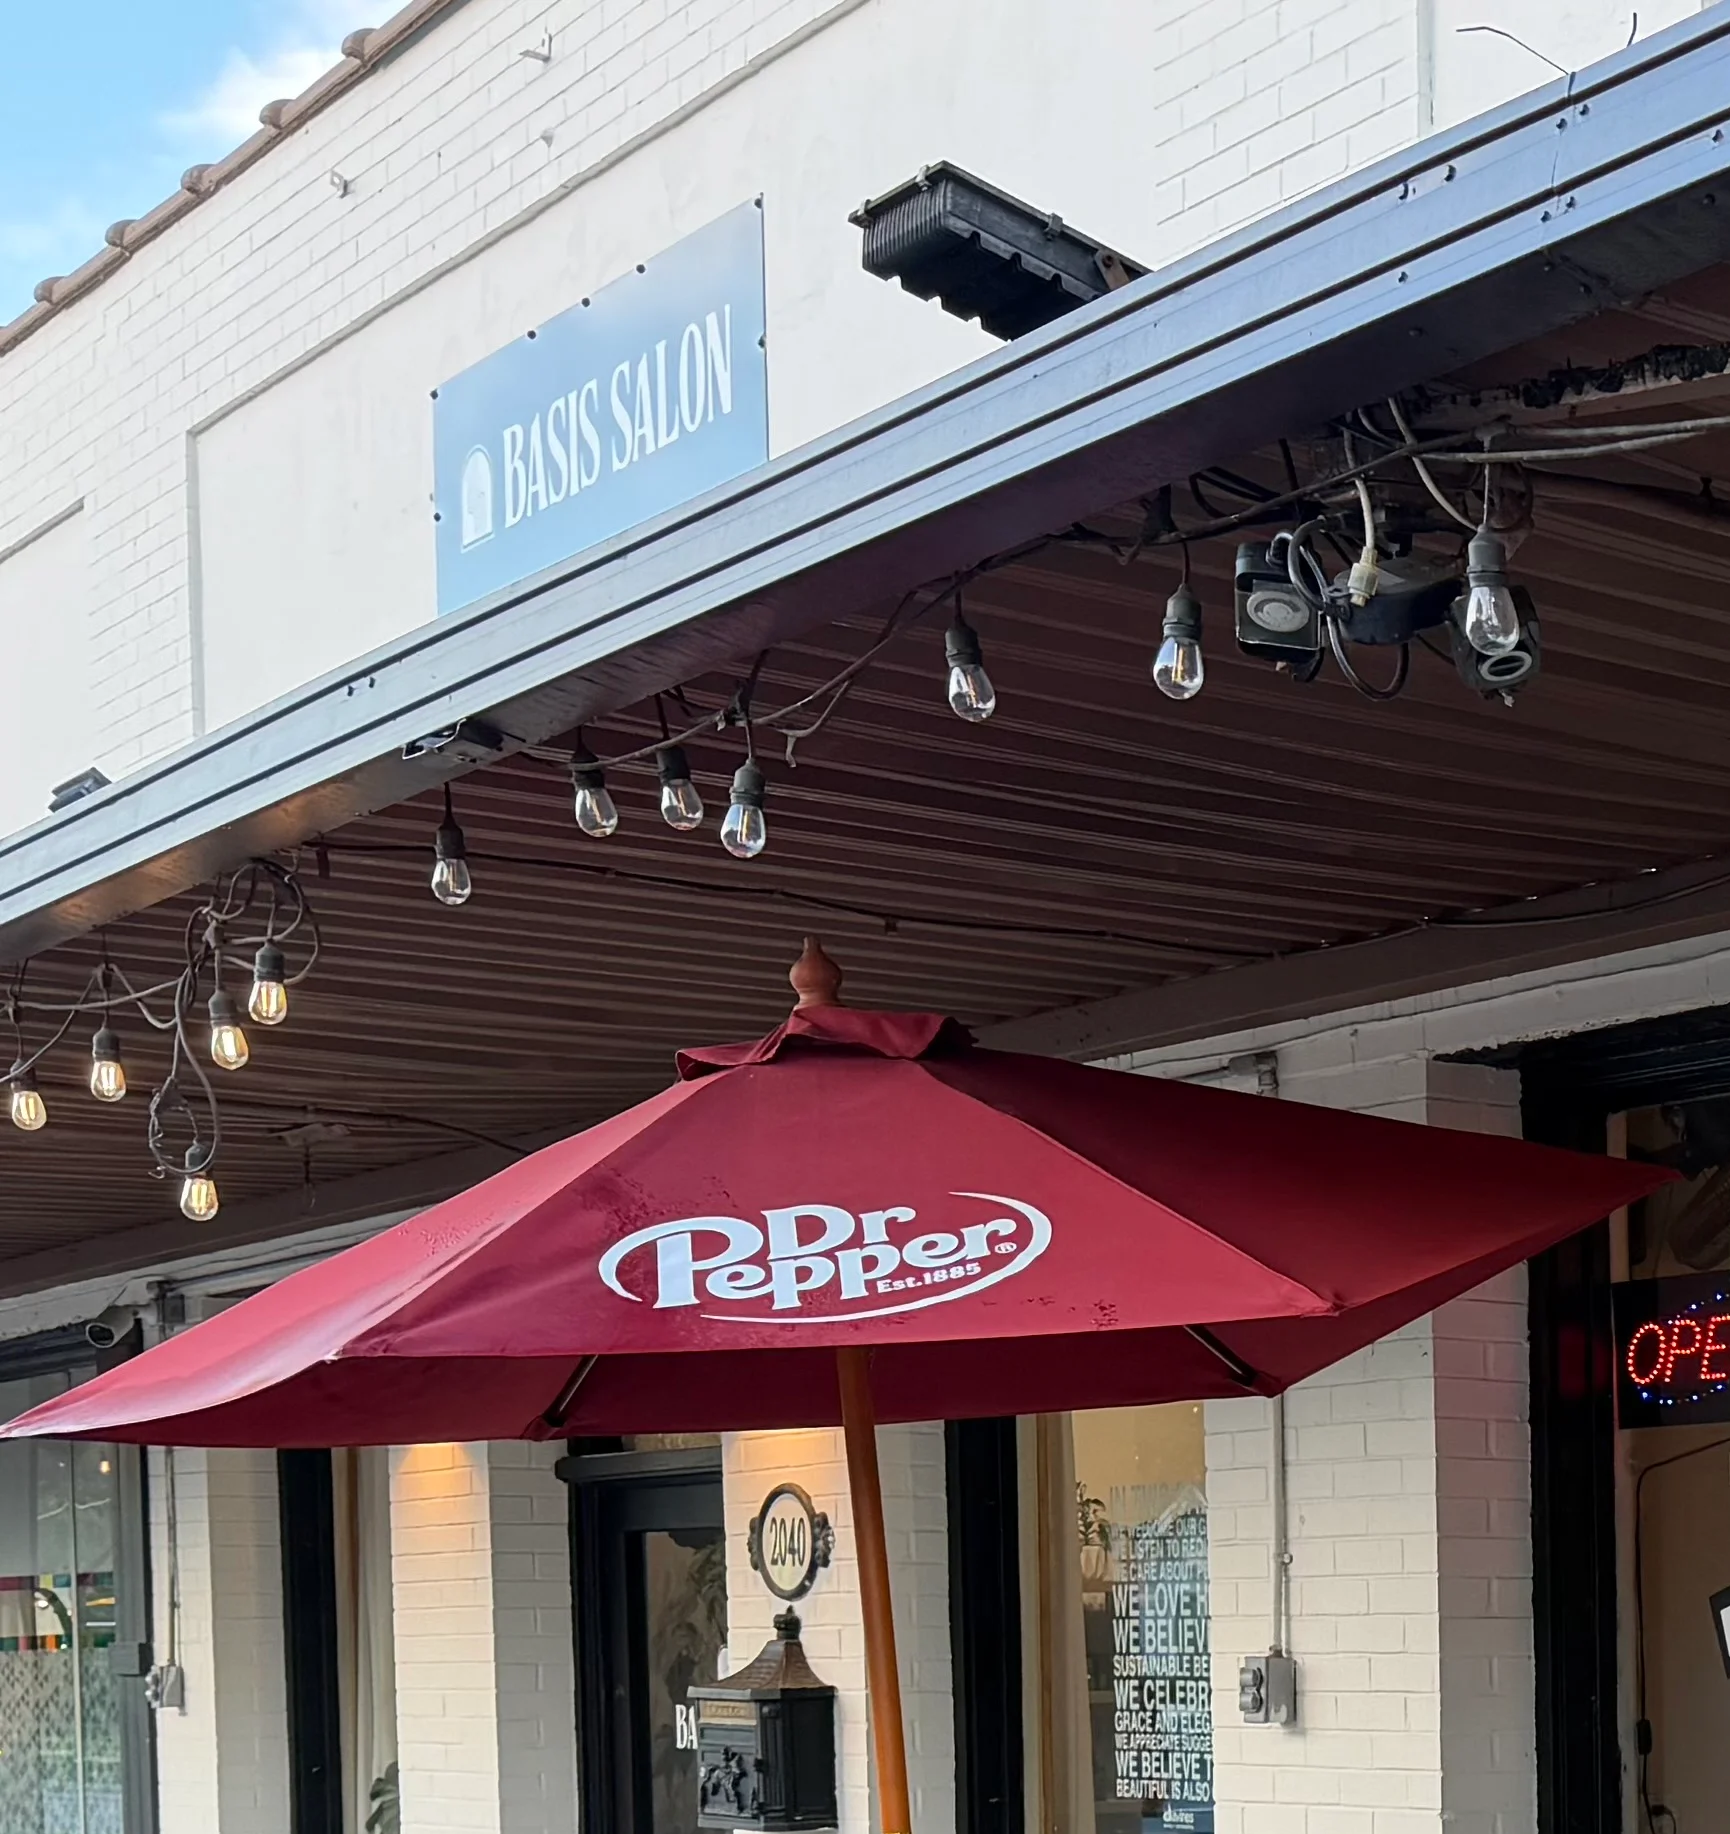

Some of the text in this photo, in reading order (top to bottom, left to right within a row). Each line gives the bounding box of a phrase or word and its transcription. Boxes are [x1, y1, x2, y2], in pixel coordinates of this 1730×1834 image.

[503, 304, 732, 529] BASIS SALON
[761, 1204, 917, 1261] Dr
[599, 1216, 1017, 1311] Pepper
[770, 1516, 806, 1568] 2040
[1129, 1539, 1180, 1559] LISTEN TO
[1129, 1561, 1194, 1581] CARE ABOUT
[1112, 1583, 1191, 1617] WE LOVE
[1112, 1618, 1140, 1653] WE
[1113, 1655, 1190, 1677] SUSTAINABLE
[1114, 1680, 1140, 1710] WE
[1115, 1711, 1212, 1734] GRACE AND ELEG
[1115, 1734, 1129, 1749] WE
[1129, 1734, 1180, 1750] APPRECIATE
[1115, 1751, 1200, 1780] WE BELIEVE
[1117, 1779, 1210, 1802] BEAUTIFUL IS ALSO
